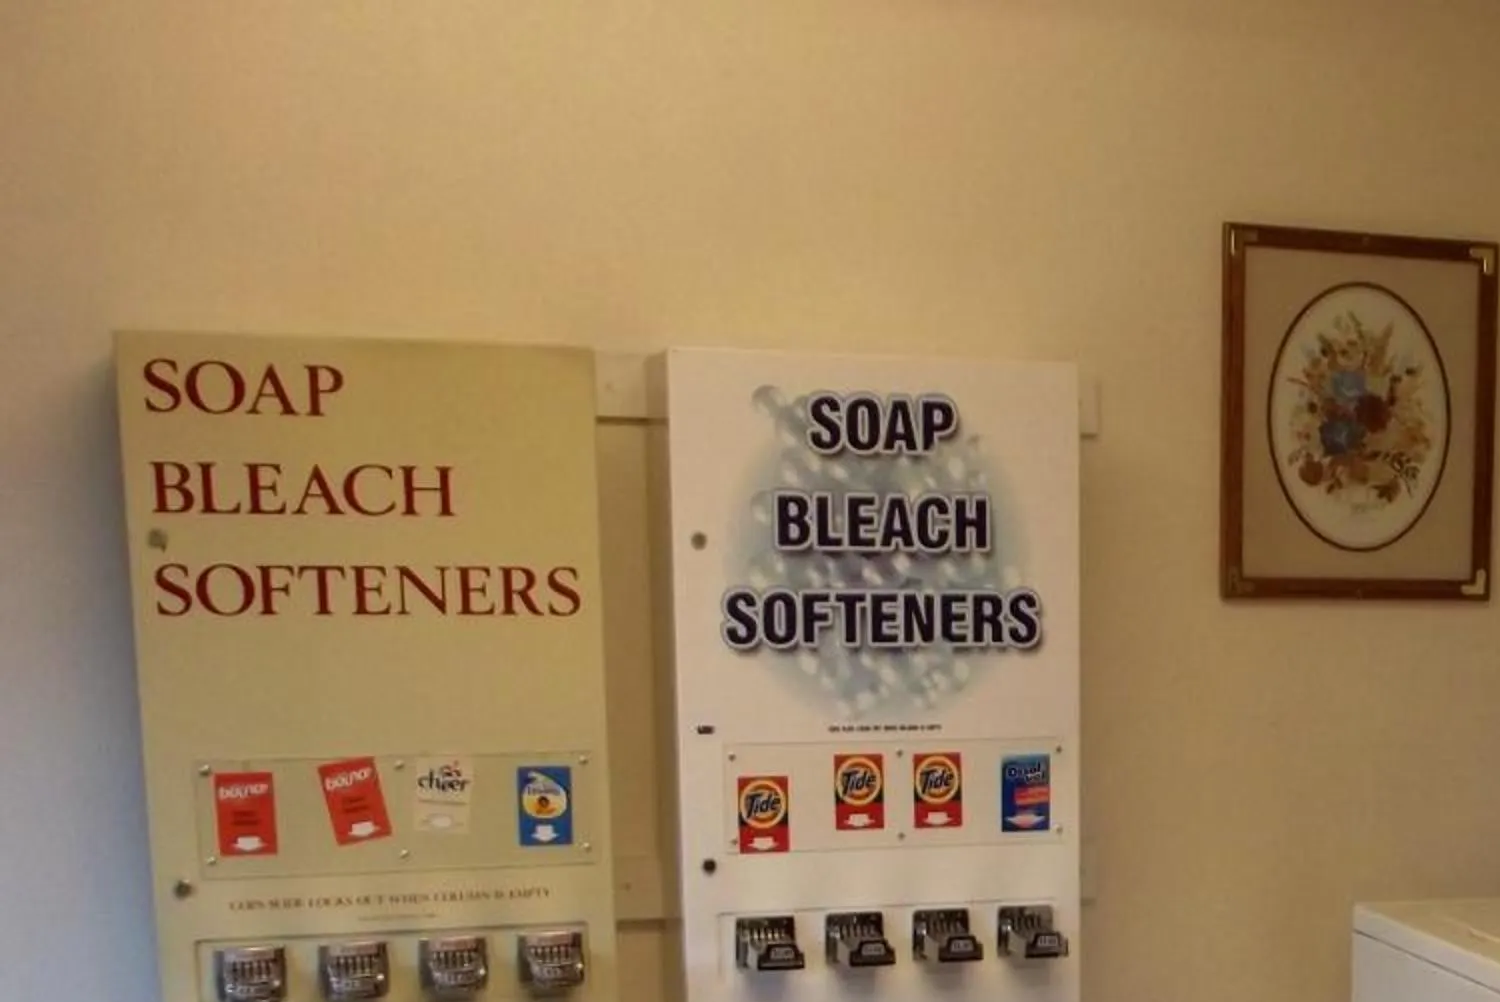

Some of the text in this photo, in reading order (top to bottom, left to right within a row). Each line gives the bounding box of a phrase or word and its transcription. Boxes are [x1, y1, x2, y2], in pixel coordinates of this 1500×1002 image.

[143, 357, 345, 417] SOAP
[808, 394, 957, 454] SOAP
[149, 461, 457, 517] BLEACH
[774, 493, 991, 550] BLEACH
[154, 562, 582, 617] SOFTENERS
[723, 589, 1041, 648] SOFTENERS
[417, 767, 471, 793] cheer
[745, 791, 782, 819] Tide
[841, 768, 877, 796] Tide
[919, 767, 955, 795] Tide
